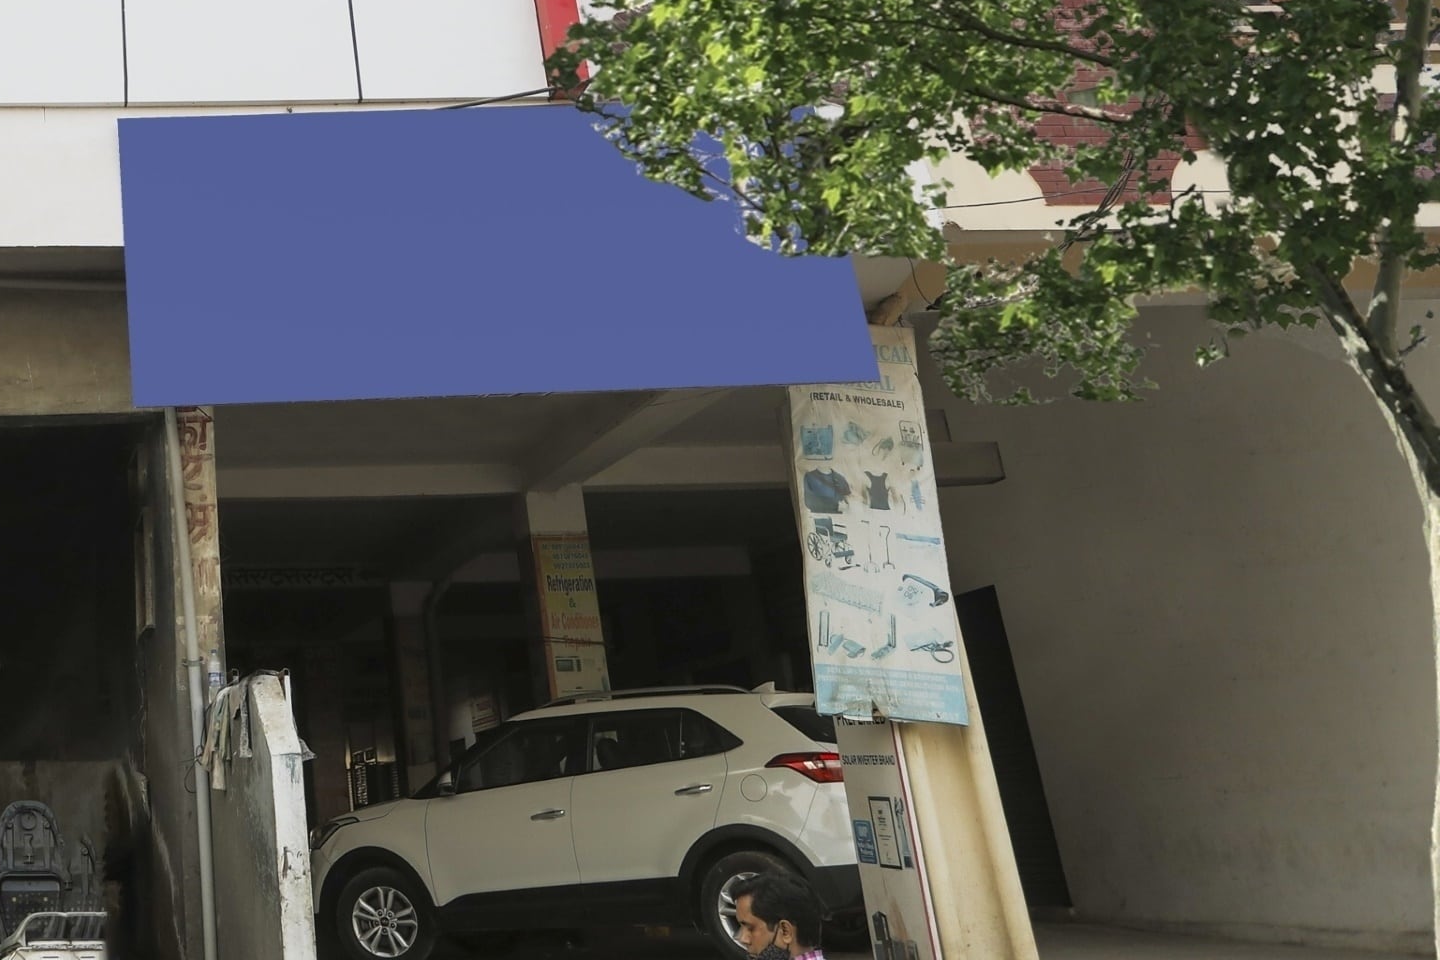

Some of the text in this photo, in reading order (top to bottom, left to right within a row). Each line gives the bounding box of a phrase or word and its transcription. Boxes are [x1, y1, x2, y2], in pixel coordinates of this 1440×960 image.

[809, 391, 905, 411] (RETAIL & WHOLESALE)
[546, 574, 594, 595] Refrigeration
